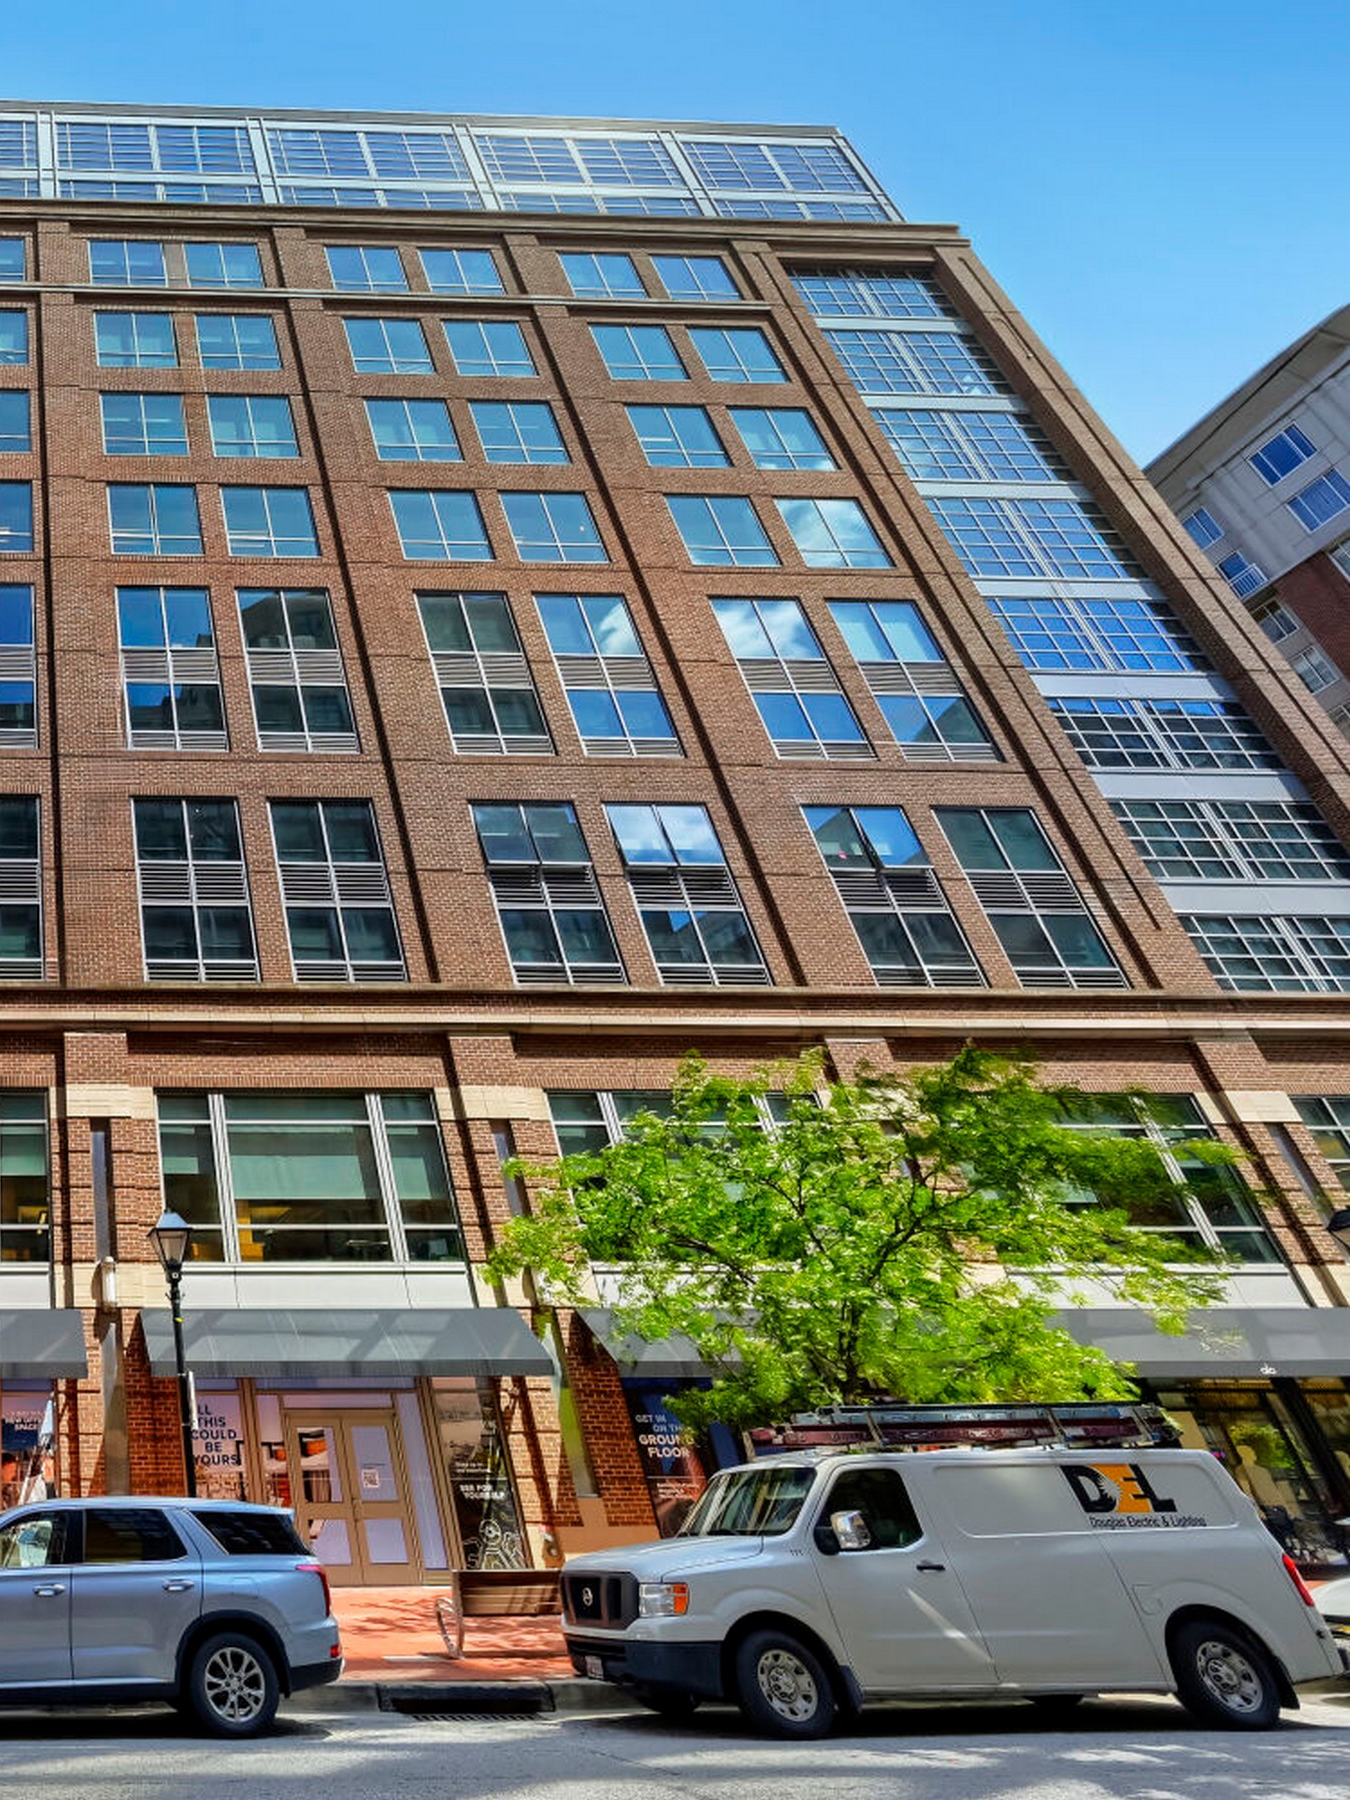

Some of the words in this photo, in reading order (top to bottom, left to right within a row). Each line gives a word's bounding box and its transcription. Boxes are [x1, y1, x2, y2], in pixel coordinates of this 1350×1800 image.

[197, 1416, 226, 1428] THIS
[635, 1414, 654, 1423] GET
[653, 1423, 667, 1432] ON
[668, 1424, 682, 1432] TH
[190, 1429, 237, 1440] COULD
[205, 1441, 222, 1453] BE
[647, 1446, 691, 1458] FLOOR
[193, 1454, 238, 1466] YOURS
[1059, 1463, 1178, 1513] DEL
[1089, 1516, 1126, 1530] Douglas
[1127, 1515, 1158, 1528] Electric
[1161, 1515, 1170, 1528] &
[1171, 1515, 1207, 1528] Lighting
